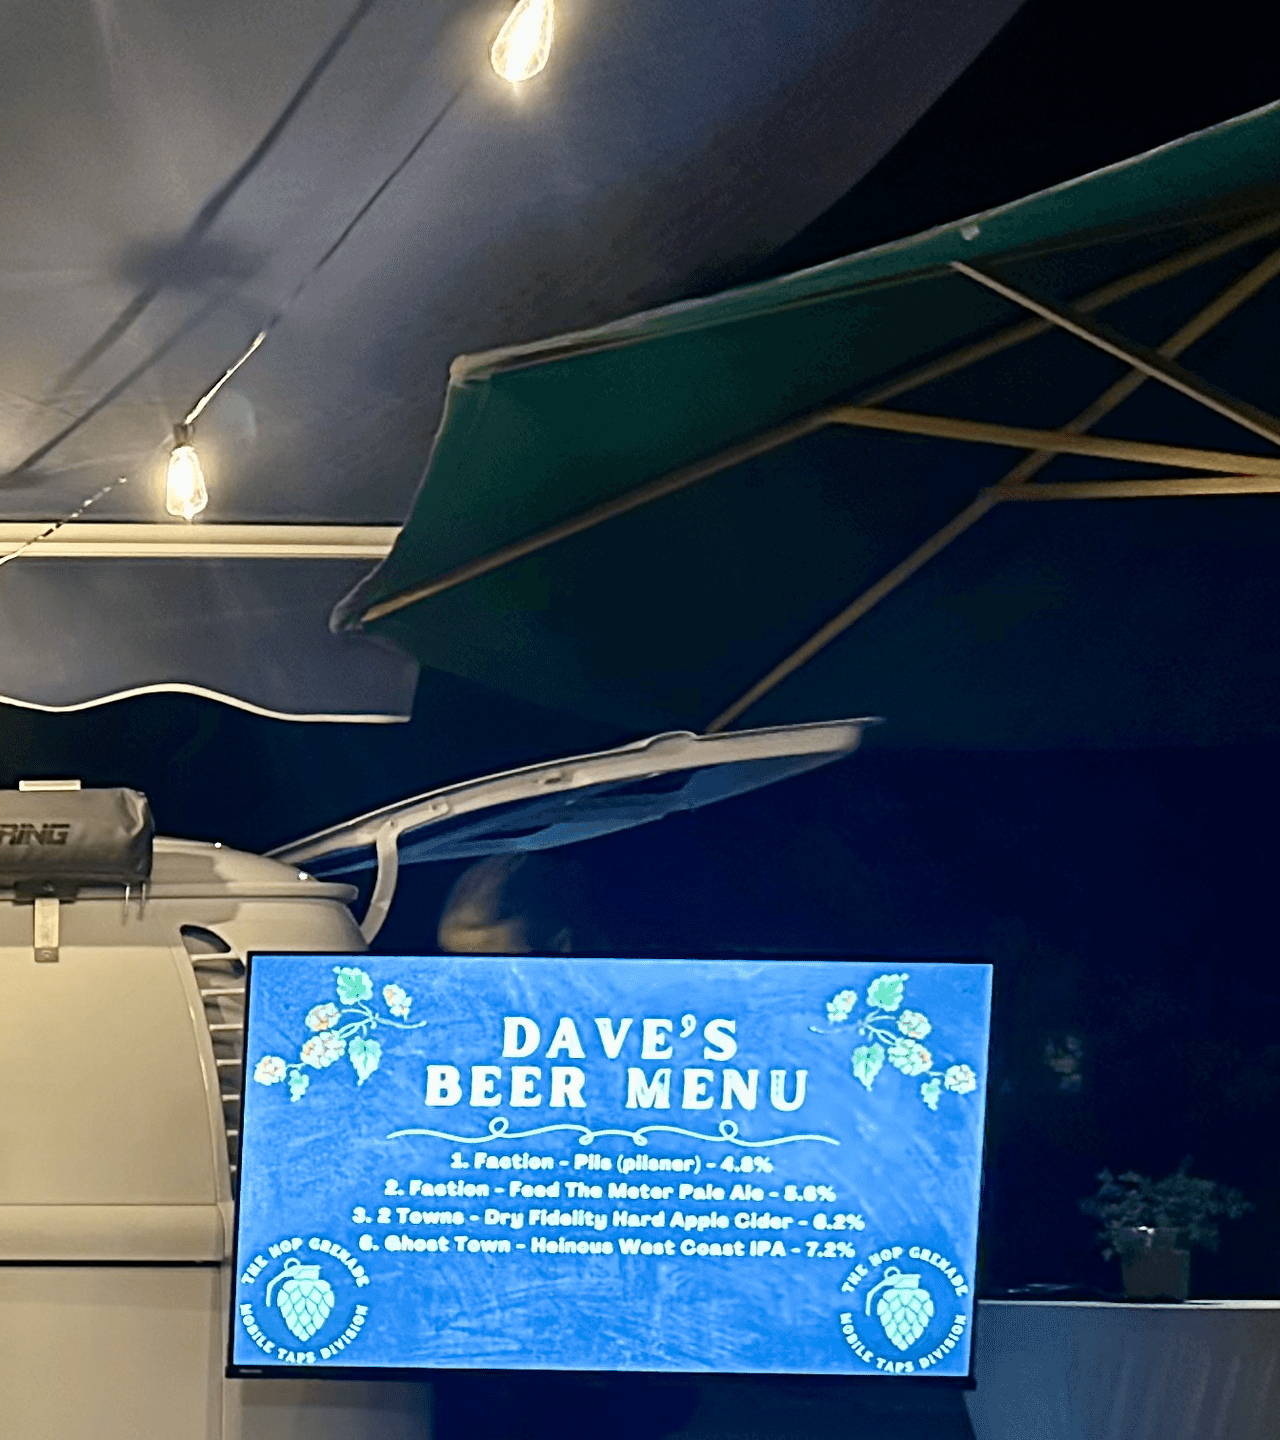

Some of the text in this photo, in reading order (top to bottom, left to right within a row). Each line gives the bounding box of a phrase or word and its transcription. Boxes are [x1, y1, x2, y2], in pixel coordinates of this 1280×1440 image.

[502, 1014, 738, 1061] DAVE'S
[425, 1064, 808, 1112] BEER MENU
[451, 1152, 469, 1169] 1.
[474, 1152, 554, 1170] Faction
[574, 1153, 612, 1170] Pils
[384, 1179, 404, 1196] 2.
[409, 1180, 489, 1197] Faction
[565, 1181, 603, 1198] The
[679, 1183, 725, 1200] Pale
[729, 1184, 764, 1201] Ale
[352, 1206, 372, 1224] 3.
[377, 1207, 391, 1224] 2
[396, 1208, 465, 1225] Towns
[484, 1208, 523, 1229] Dry
[528, 1209, 607, 1230] Fidelity
[612, 1210, 665, 1228] Hard
[669, 1211, 729, 1231] Apple
[734, 1212, 793, 1230] Cider
[241, 1237, 370, 1288] THE HOP GRENADE
[384, 1234, 449, 1252] Ghost
[454, 1235, 511, 1252] Town
[531, 1237, 614, 1254] Heinous
[619, 1238, 676, 1255] West
[680, 1239, 745, 1256] Coast
[750, 1240, 786, 1257] IPA
[841, 1246, 968, 1297] THE HOP GRENADE
[240, 1303, 368, 1364] MOBILE TAPS DIVISION
[840, 1313, 966, 1373] MOBILE TAPS DIVISION
